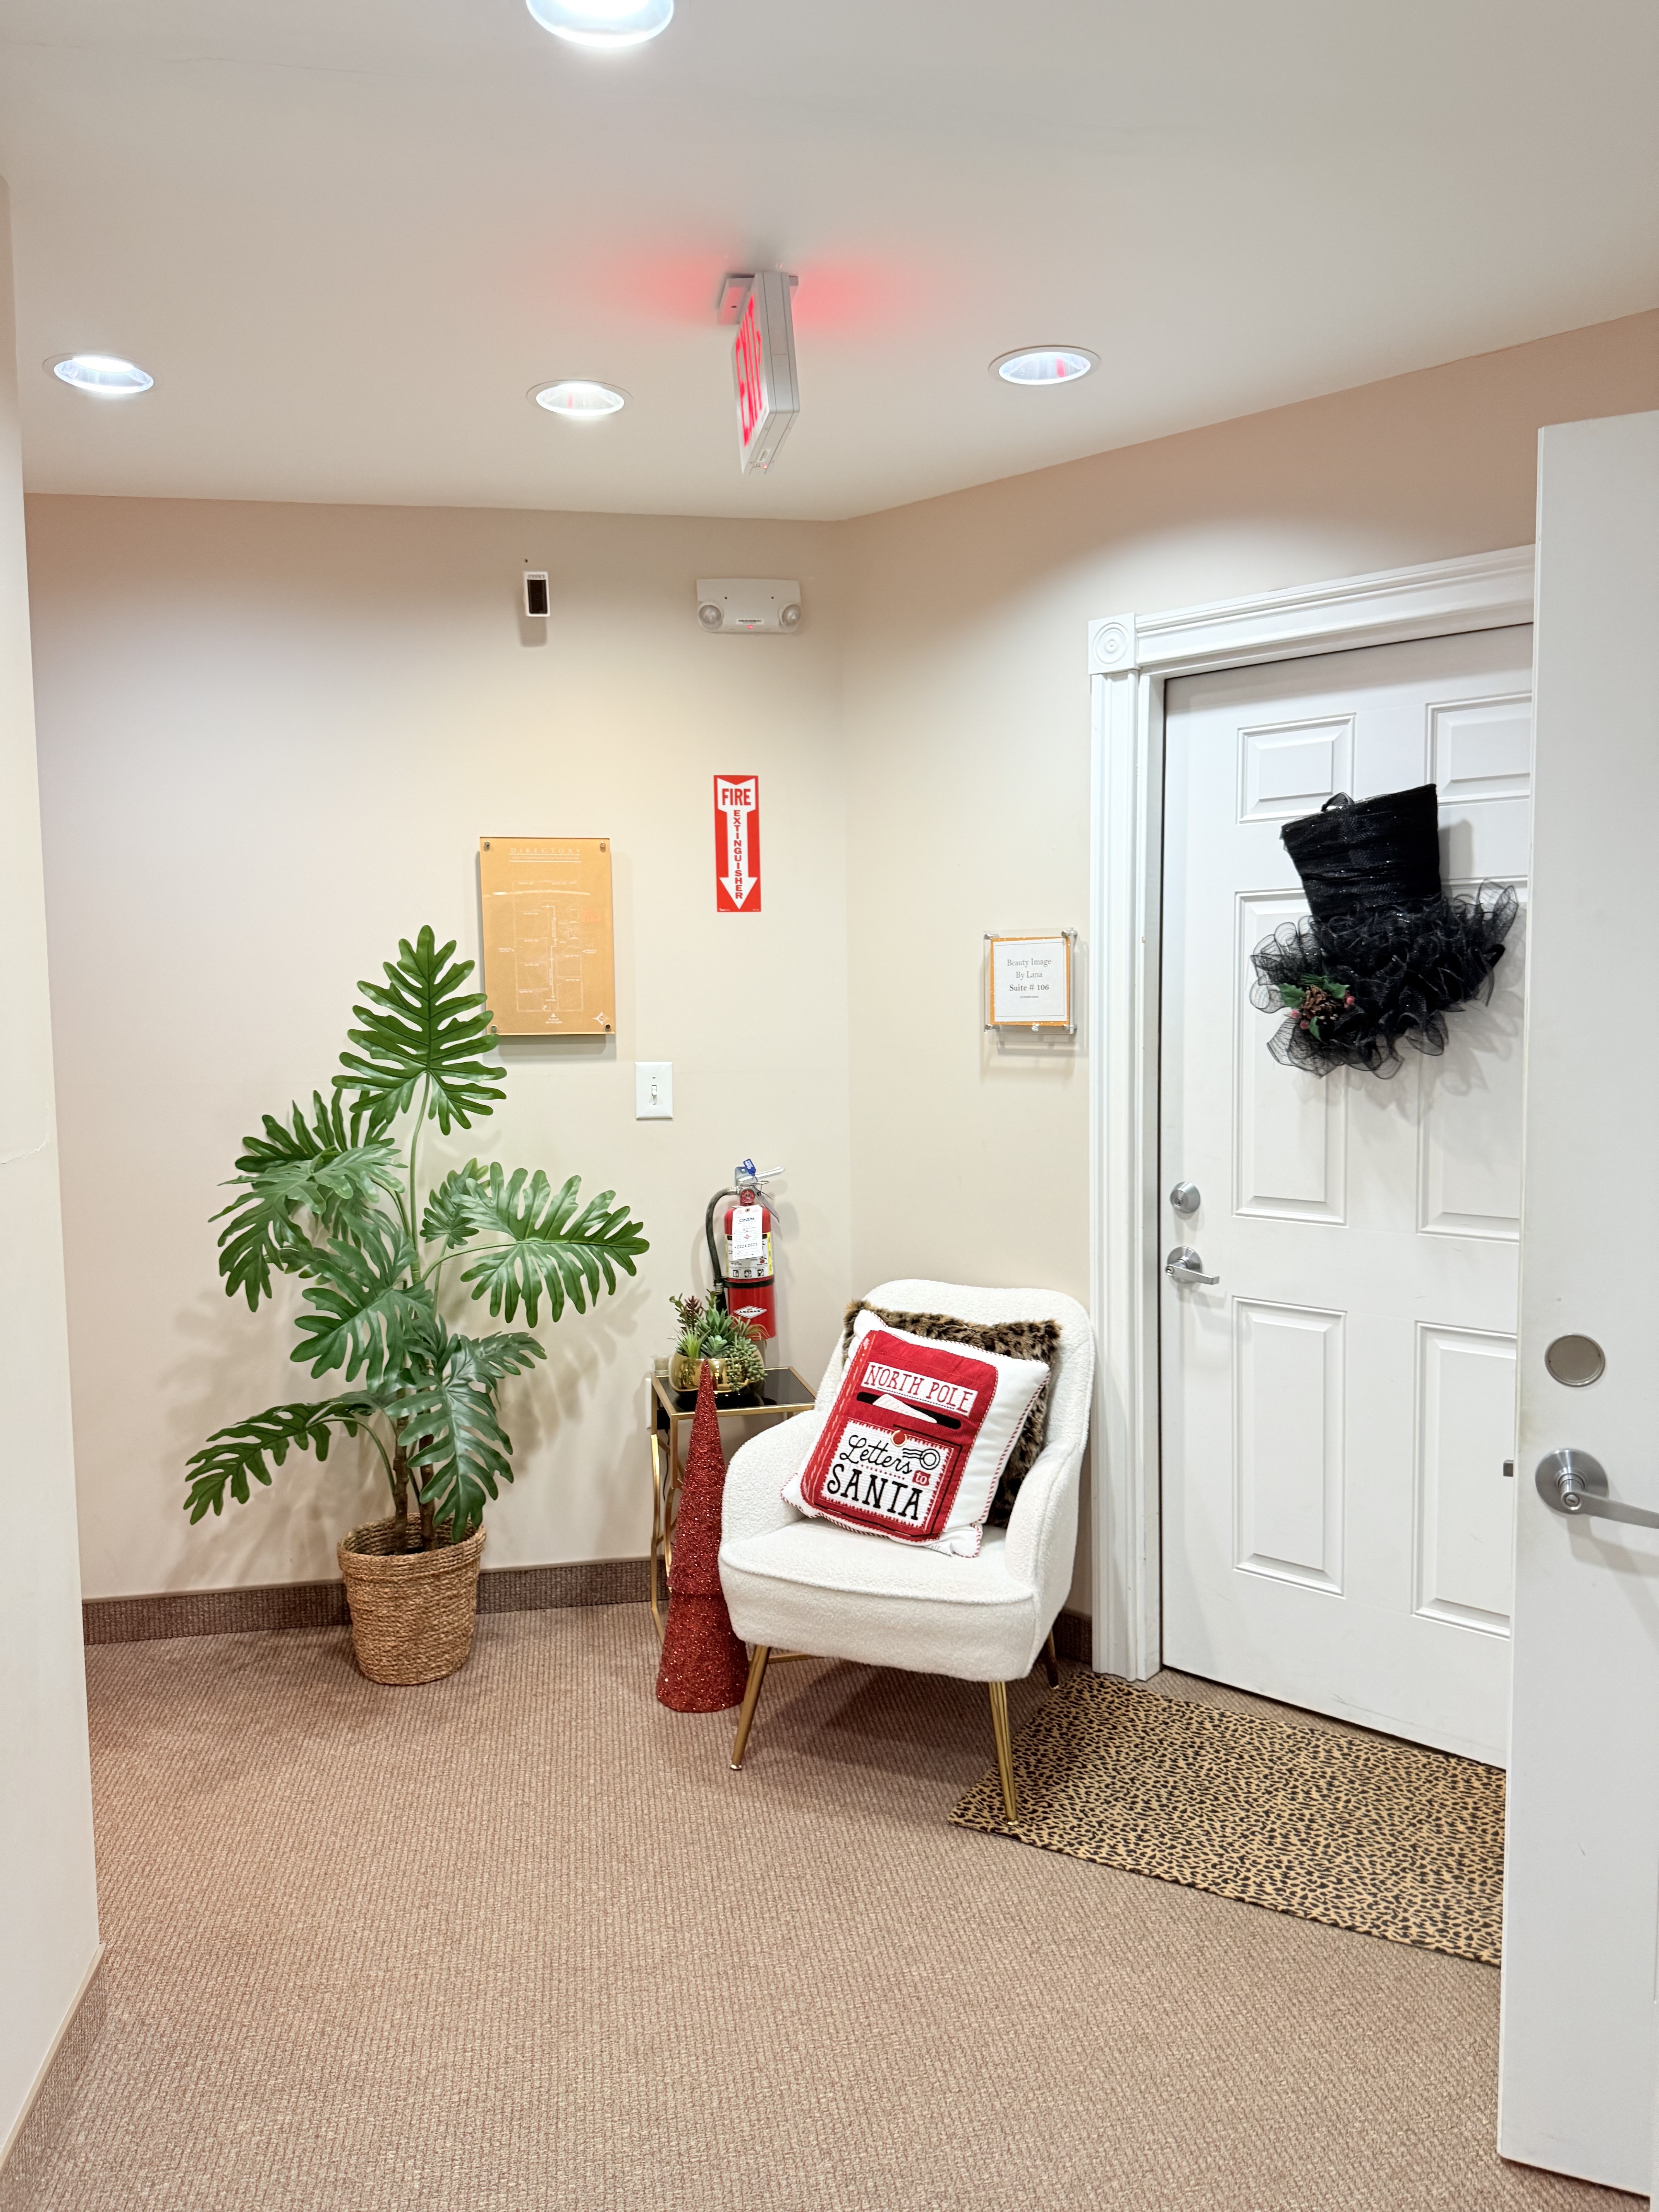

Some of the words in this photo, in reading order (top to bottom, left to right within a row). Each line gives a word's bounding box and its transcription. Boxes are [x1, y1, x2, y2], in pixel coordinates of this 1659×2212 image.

[722, 788, 751, 806] FIRE
[733, 809, 743, 899] EXTINGUISHER
[1007, 958, 1029, 967] Beauty
[1031, 958, 1051, 967] Image
[1016, 971, 1025, 980] By
[864, 1365, 925, 1395] NORTH
[926, 1381, 975, 1413] POLE
[840, 1434, 912, 1474] Letters
[827, 1463, 923, 1521] SANTA
[915, 1472, 928, 1485] to
